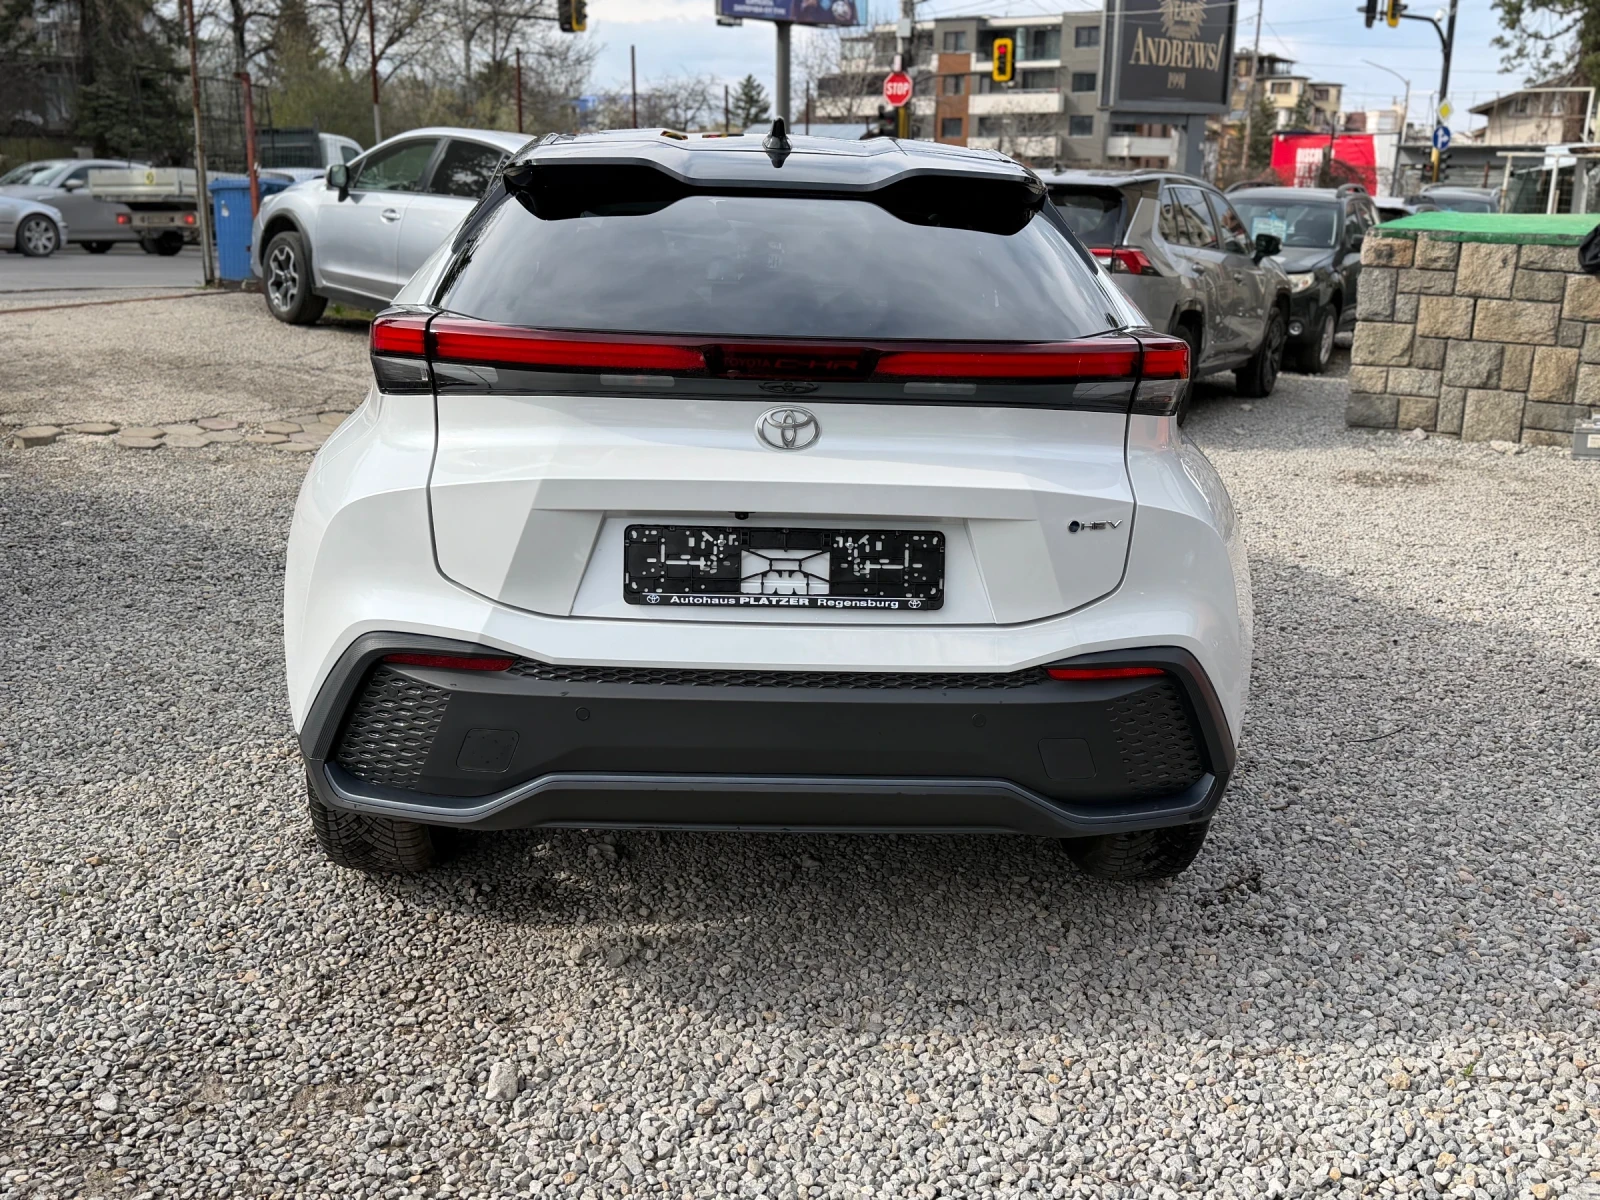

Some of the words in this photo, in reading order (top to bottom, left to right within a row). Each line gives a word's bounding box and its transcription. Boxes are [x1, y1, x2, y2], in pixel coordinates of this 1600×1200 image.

[886, 82, 909, 96] STOP
[724, 357, 770, 369] TOYOTA
[774, 358, 858, 370] C-HR
[1080, 519, 1123, 531] HEV
[670, 595, 736, 605] Autohaus
[739, 596, 809, 606] PLATZER
[817, 598, 899, 609] Regensburg
